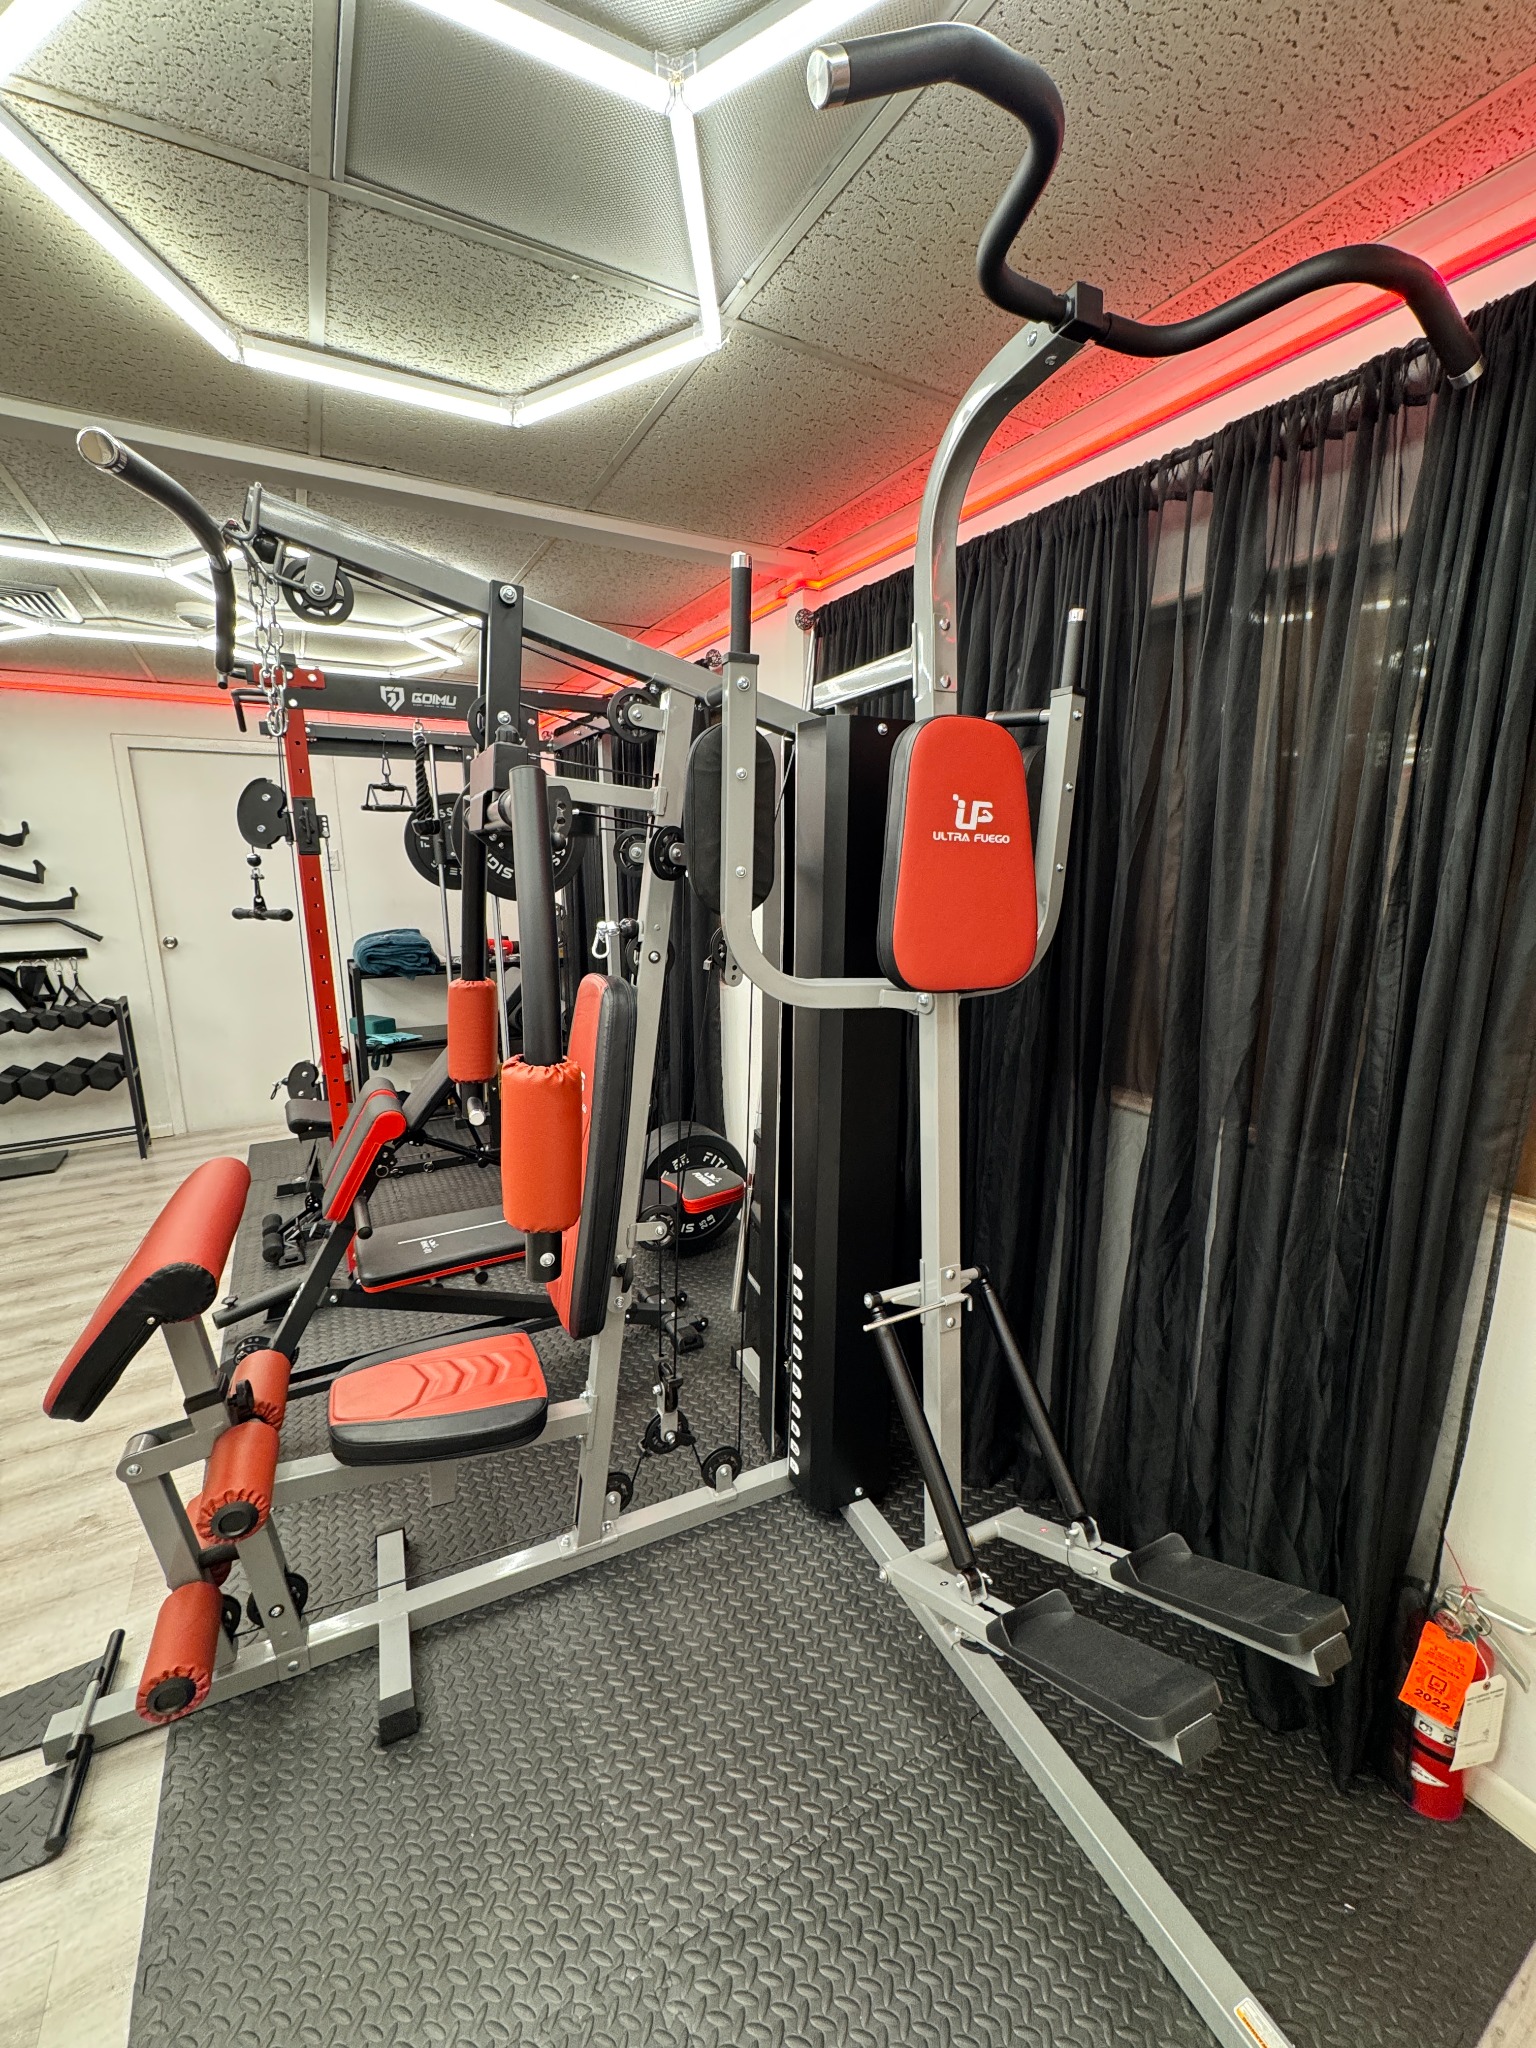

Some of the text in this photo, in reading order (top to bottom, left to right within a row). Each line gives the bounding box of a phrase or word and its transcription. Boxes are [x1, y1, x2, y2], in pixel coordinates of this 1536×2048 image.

[932, 831, 1010, 844] ULTRA FUEGO
[1413, 1688, 1450, 1713] 2022
